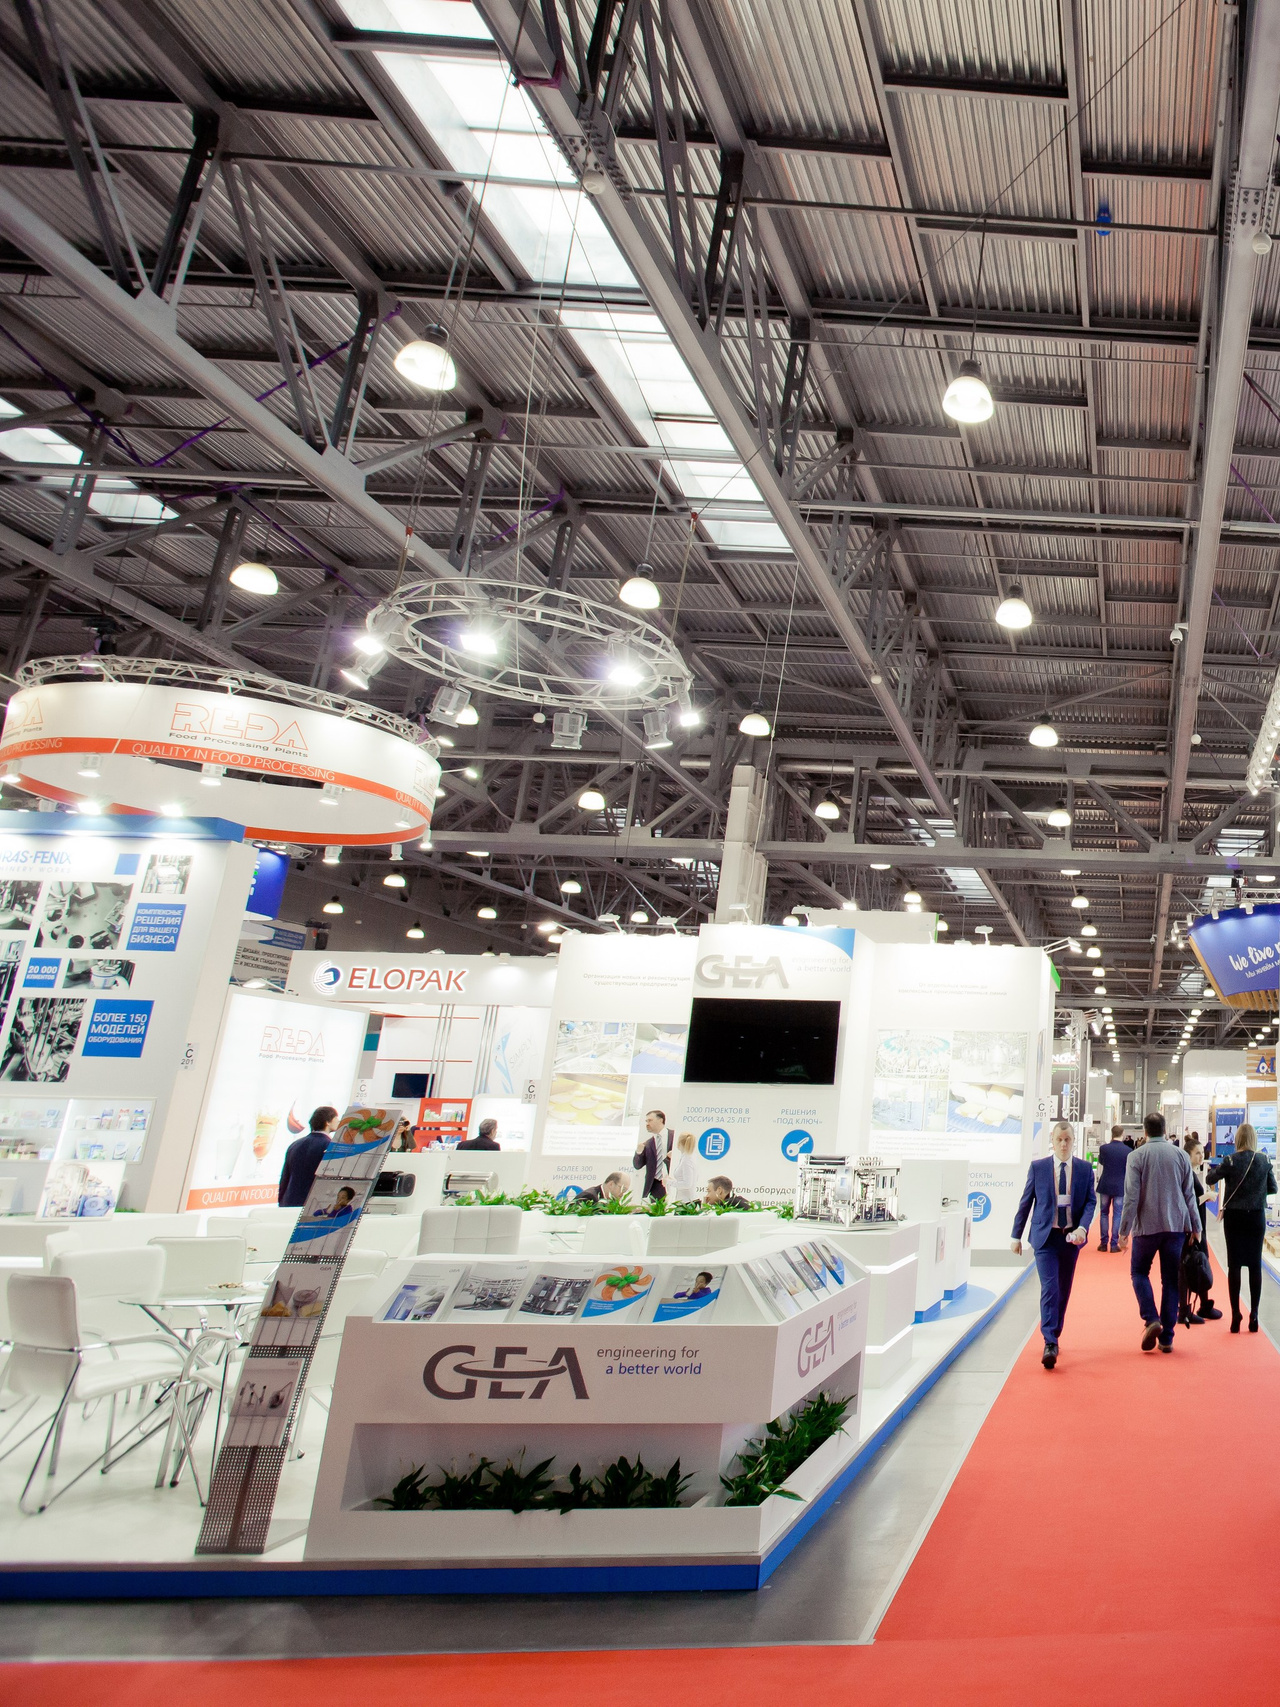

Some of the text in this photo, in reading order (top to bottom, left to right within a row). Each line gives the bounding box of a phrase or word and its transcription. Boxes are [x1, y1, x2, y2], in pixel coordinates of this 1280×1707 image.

[171, 703, 308, 750] REDA
[169, 732, 309, 758] Food Processing Plants
[132, 743, 336, 781] QUALITY IN FOOD PROCESSING
[135, 916, 181, 925] РЕШЕНИЯ
[132, 926, 179, 934] ДЛЯ ВАШЕГО
[130, 935, 175, 944] БИЗНЕСА
[1229, 946, 1274, 971] We live
[28, 966, 58, 974] 20 000
[695, 954, 790, 989] GEA
[1245, 970, 1256, 979] Мы
[348, 968, 467, 991] ELOPAK
[93, 1013, 148, 1023] БОЛЕЕ 150
[91, 1022, 145, 1035] МОДЕЛЕЙ
[88, 1036, 142, 1044] ОБОРУДОВАНИЯ
[260, 1026, 325, 1056] REDA
[275, 1054, 306, 1062] Processing
[202, 1190, 239, 1205] QUALITY
[240, 1189, 249, 1200] IN
[250, 1187, 274, 1199] FOOD
[597, 1345, 700, 1361] engineering for
[798, 1314, 835, 1378] GEA
[423, 1345, 590, 1400] GEA
[605, 1362, 702, 1375] a better world
